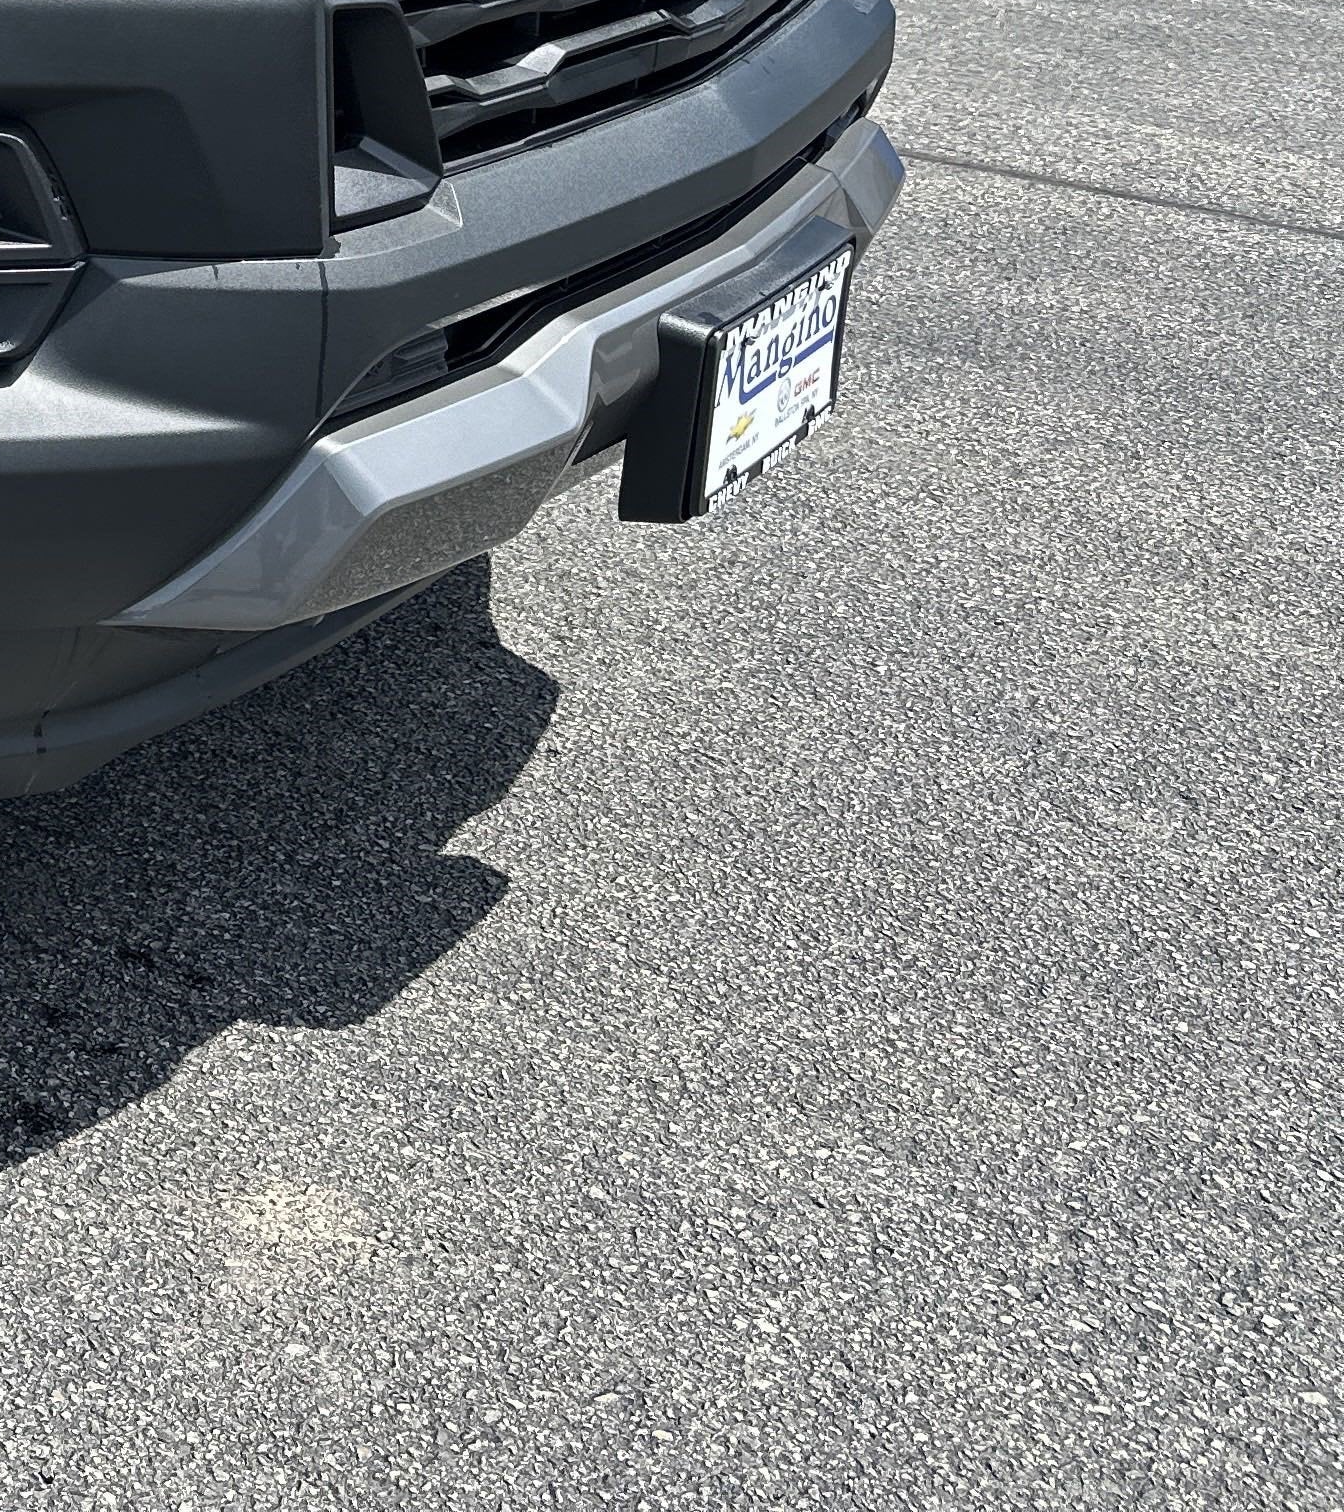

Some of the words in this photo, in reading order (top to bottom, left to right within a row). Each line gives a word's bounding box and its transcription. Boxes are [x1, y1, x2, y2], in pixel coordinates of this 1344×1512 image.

[726, 249, 851, 350] MANGINO
[714, 294, 837, 408] Mangino
[793, 368, 820, 397] GMC
[761, 434, 797, 474] BUICK
